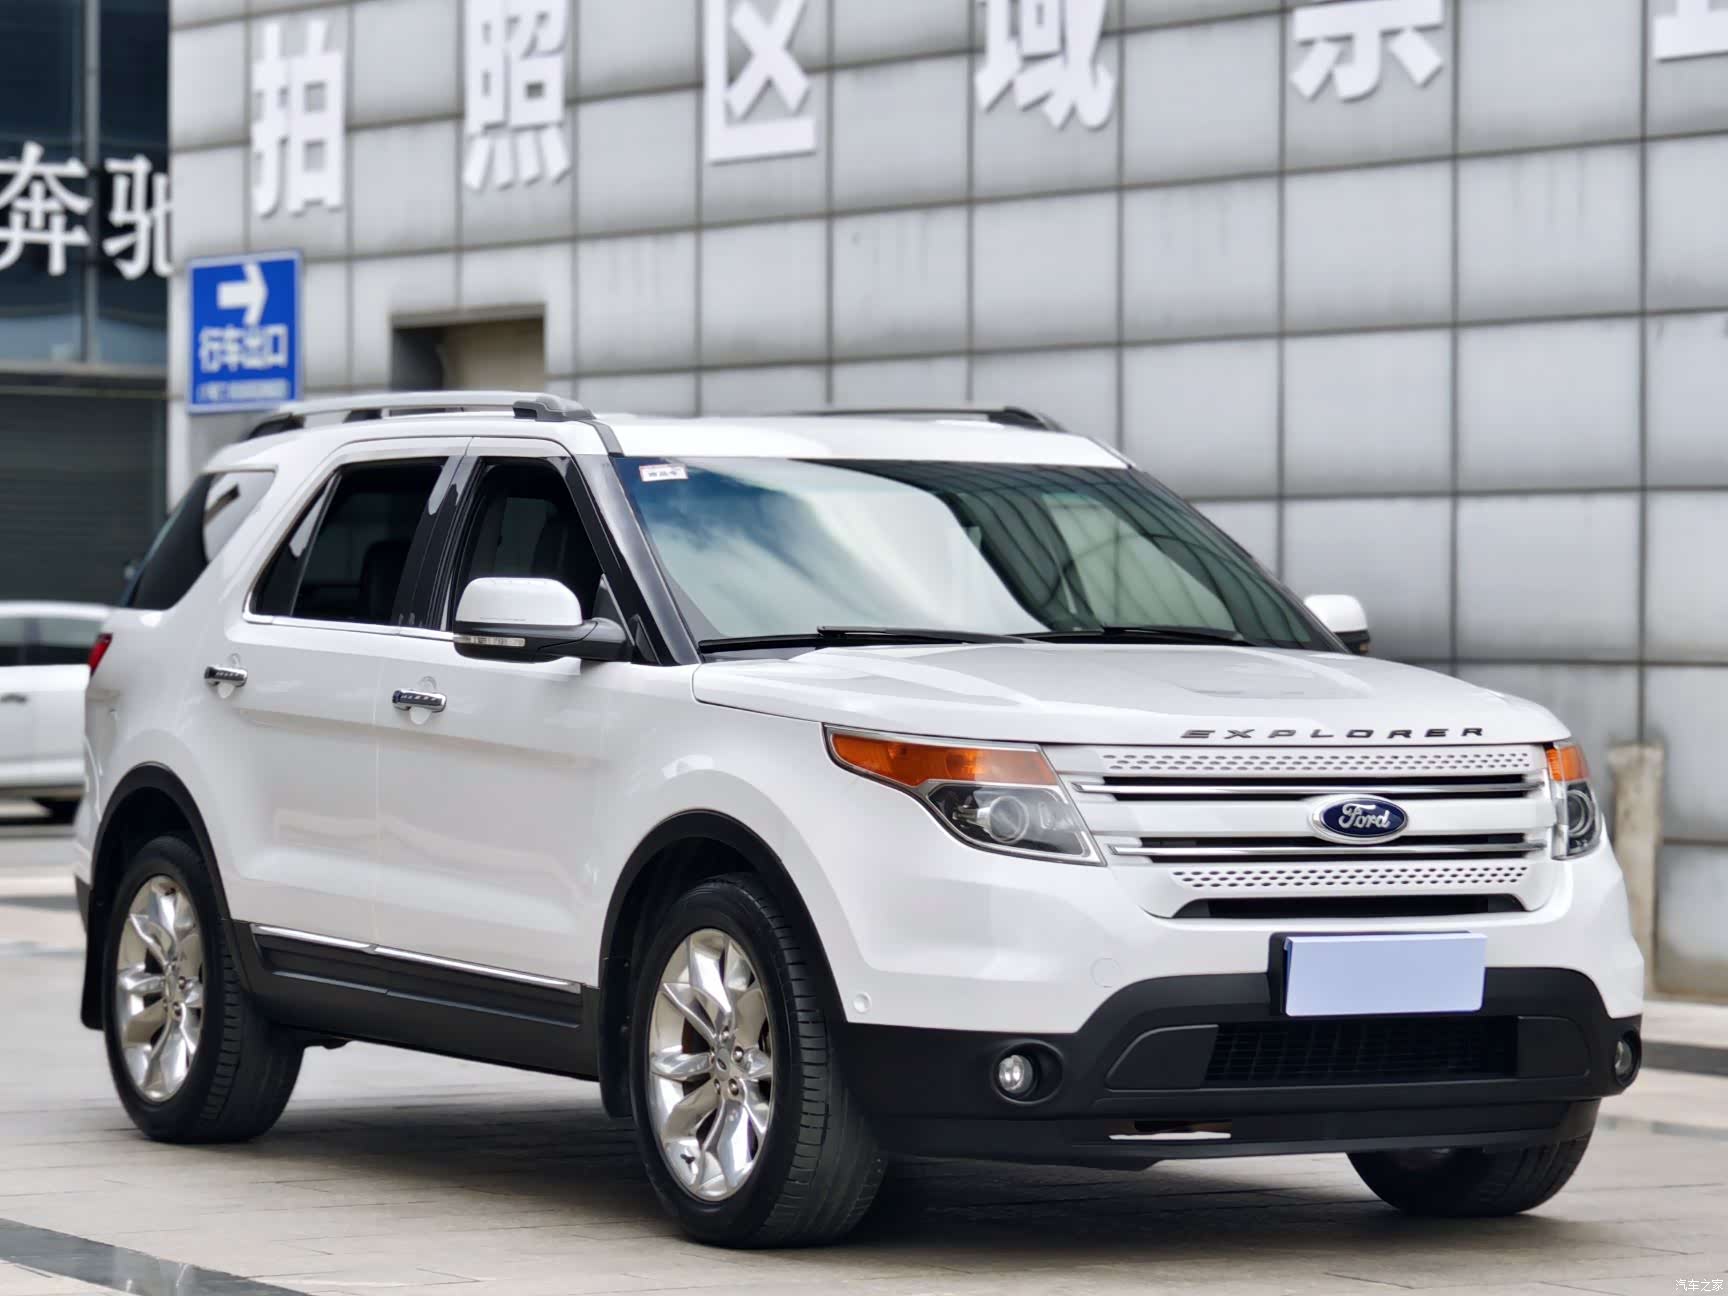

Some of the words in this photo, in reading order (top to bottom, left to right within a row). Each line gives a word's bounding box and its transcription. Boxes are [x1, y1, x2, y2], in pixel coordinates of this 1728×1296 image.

[252, 0, 1728, 217] 拍照区域
[1180, 726, 1484, 740] EXPLORER
[1337, 802, 1392, 830] Ford
